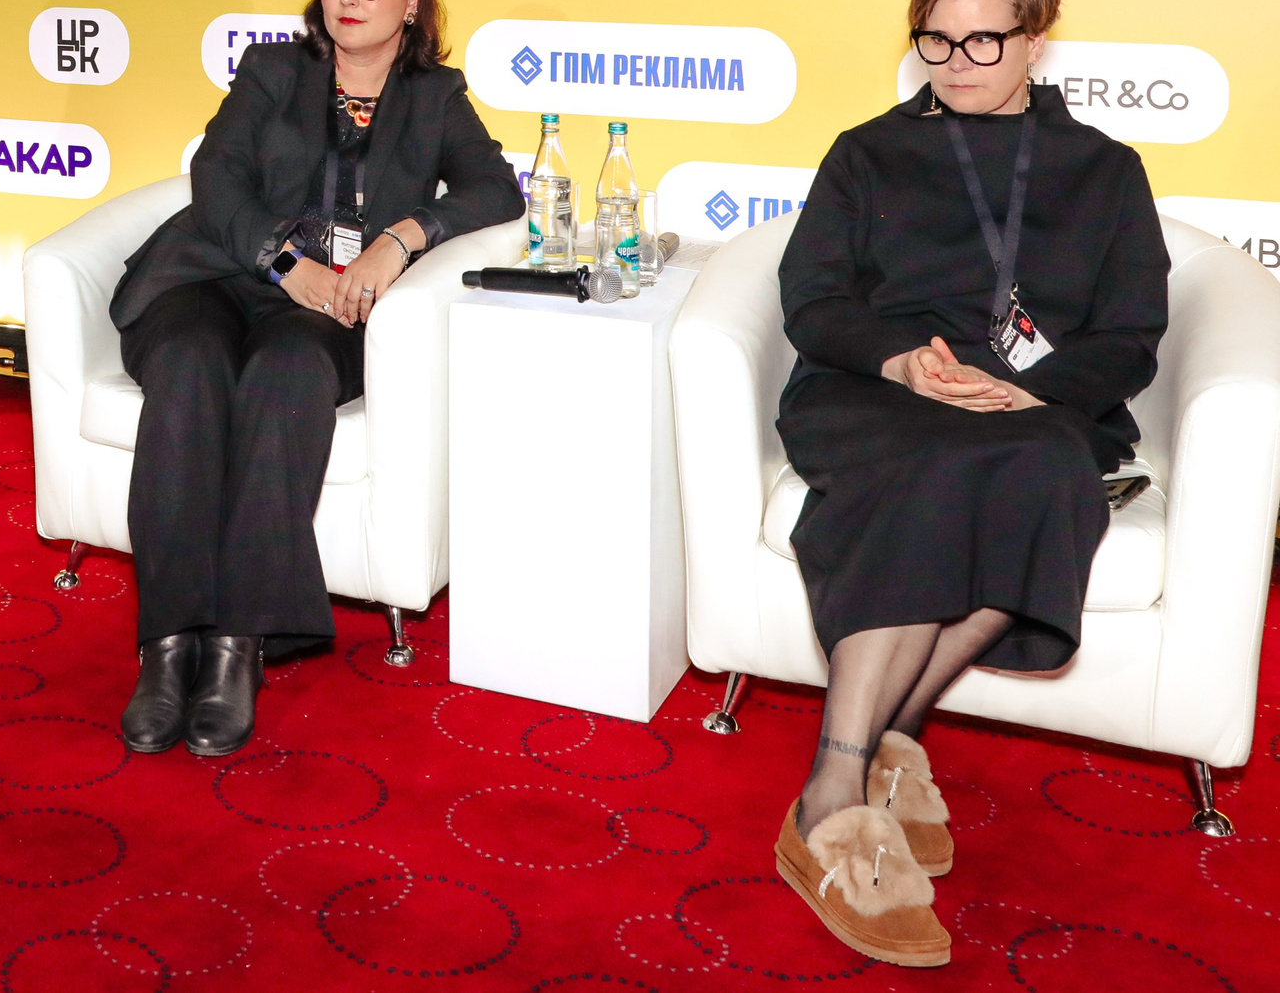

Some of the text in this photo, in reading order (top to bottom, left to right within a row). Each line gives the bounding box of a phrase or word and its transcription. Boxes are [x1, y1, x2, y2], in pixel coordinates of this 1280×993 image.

[57, 19, 100, 52] ЦР
[57, 46, 100, 74] БК
[550, 51, 745, 91] ГПМ РЕКЛАМА
